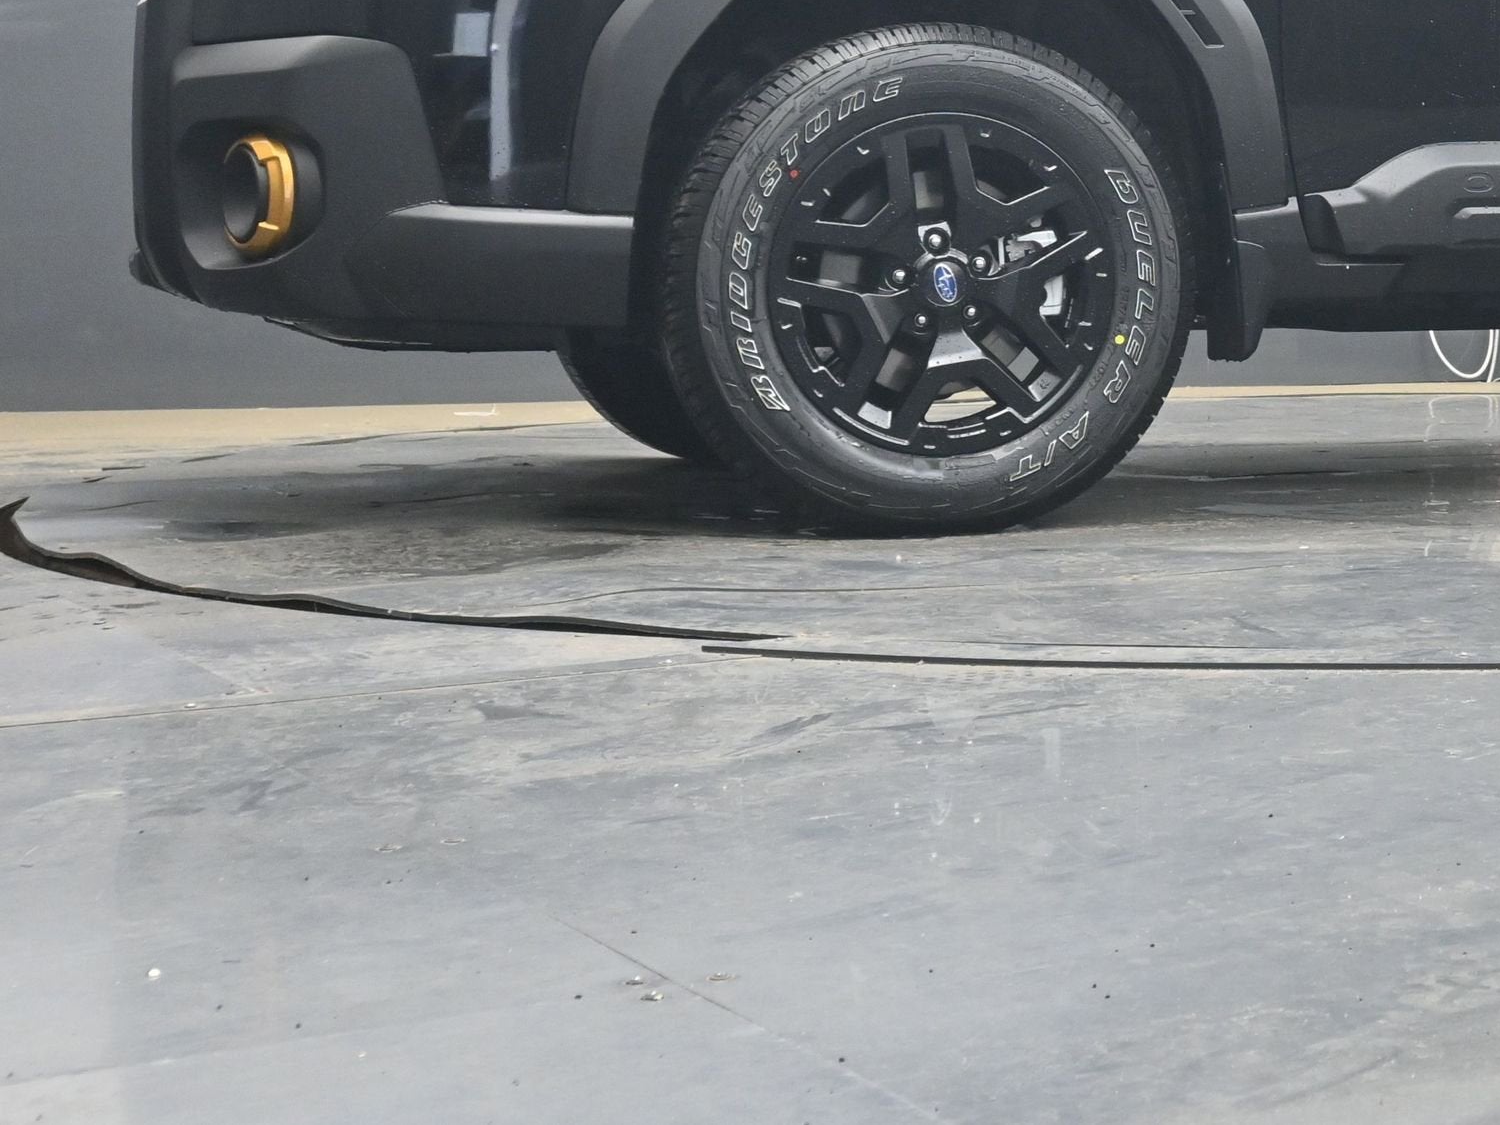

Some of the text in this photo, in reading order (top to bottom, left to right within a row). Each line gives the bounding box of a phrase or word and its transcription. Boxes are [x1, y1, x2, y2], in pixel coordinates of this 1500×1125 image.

[727, 76, 904, 412] BRIDGESTONE
[1104, 168, 1156, 404] DUELER
[1010, 411, 1090, 481] A/T
